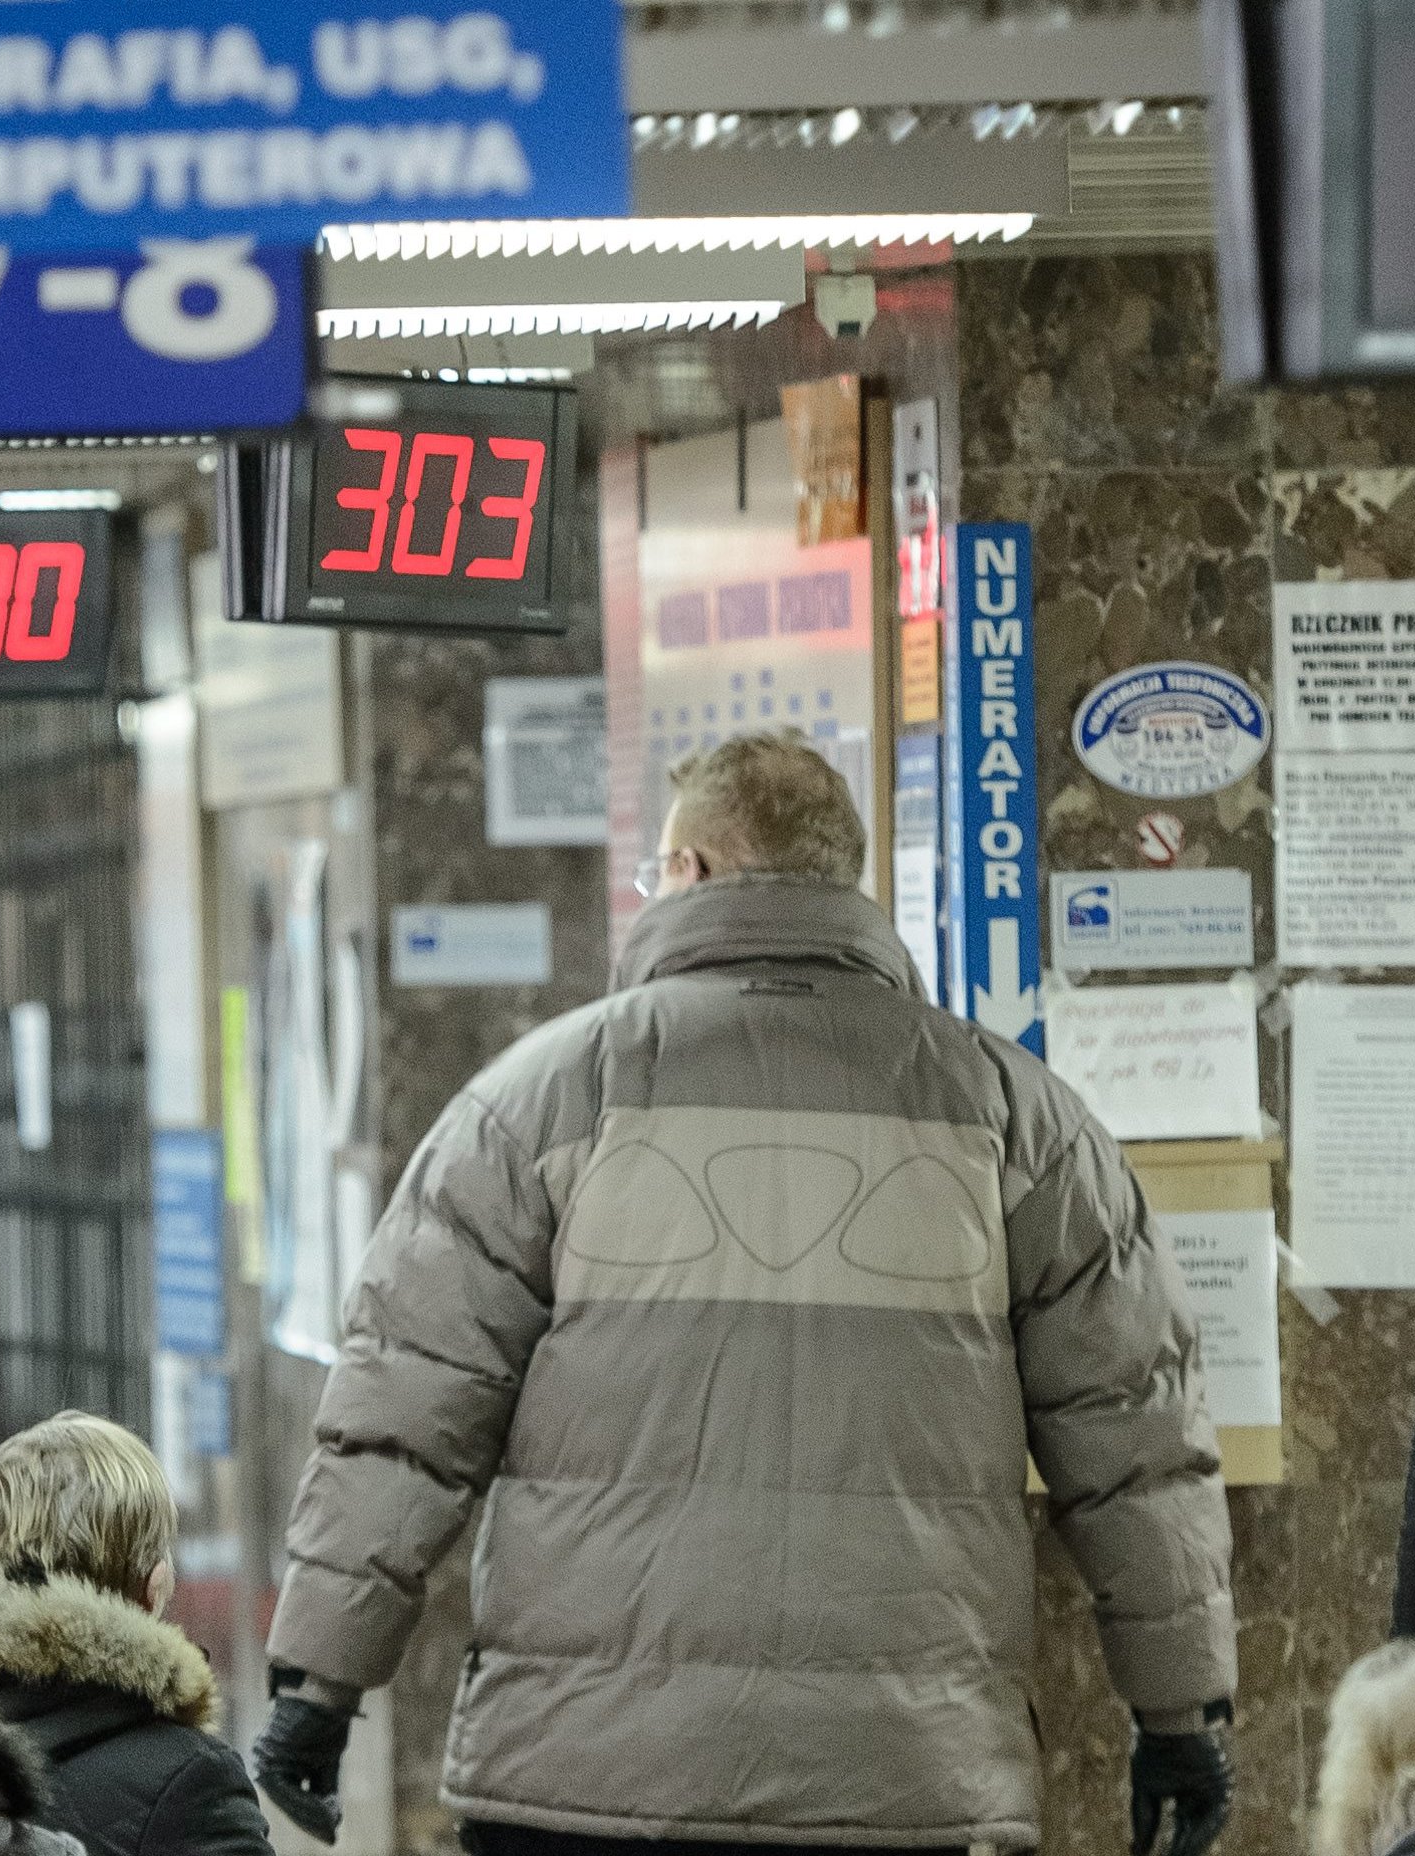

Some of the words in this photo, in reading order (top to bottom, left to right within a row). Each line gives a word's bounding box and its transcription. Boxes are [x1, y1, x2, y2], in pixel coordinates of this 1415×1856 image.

[312, 10, 545, 102] USG,
[320, 428, 546, 580] 303
[972, 538, 1023, 899] NUMERATOR
